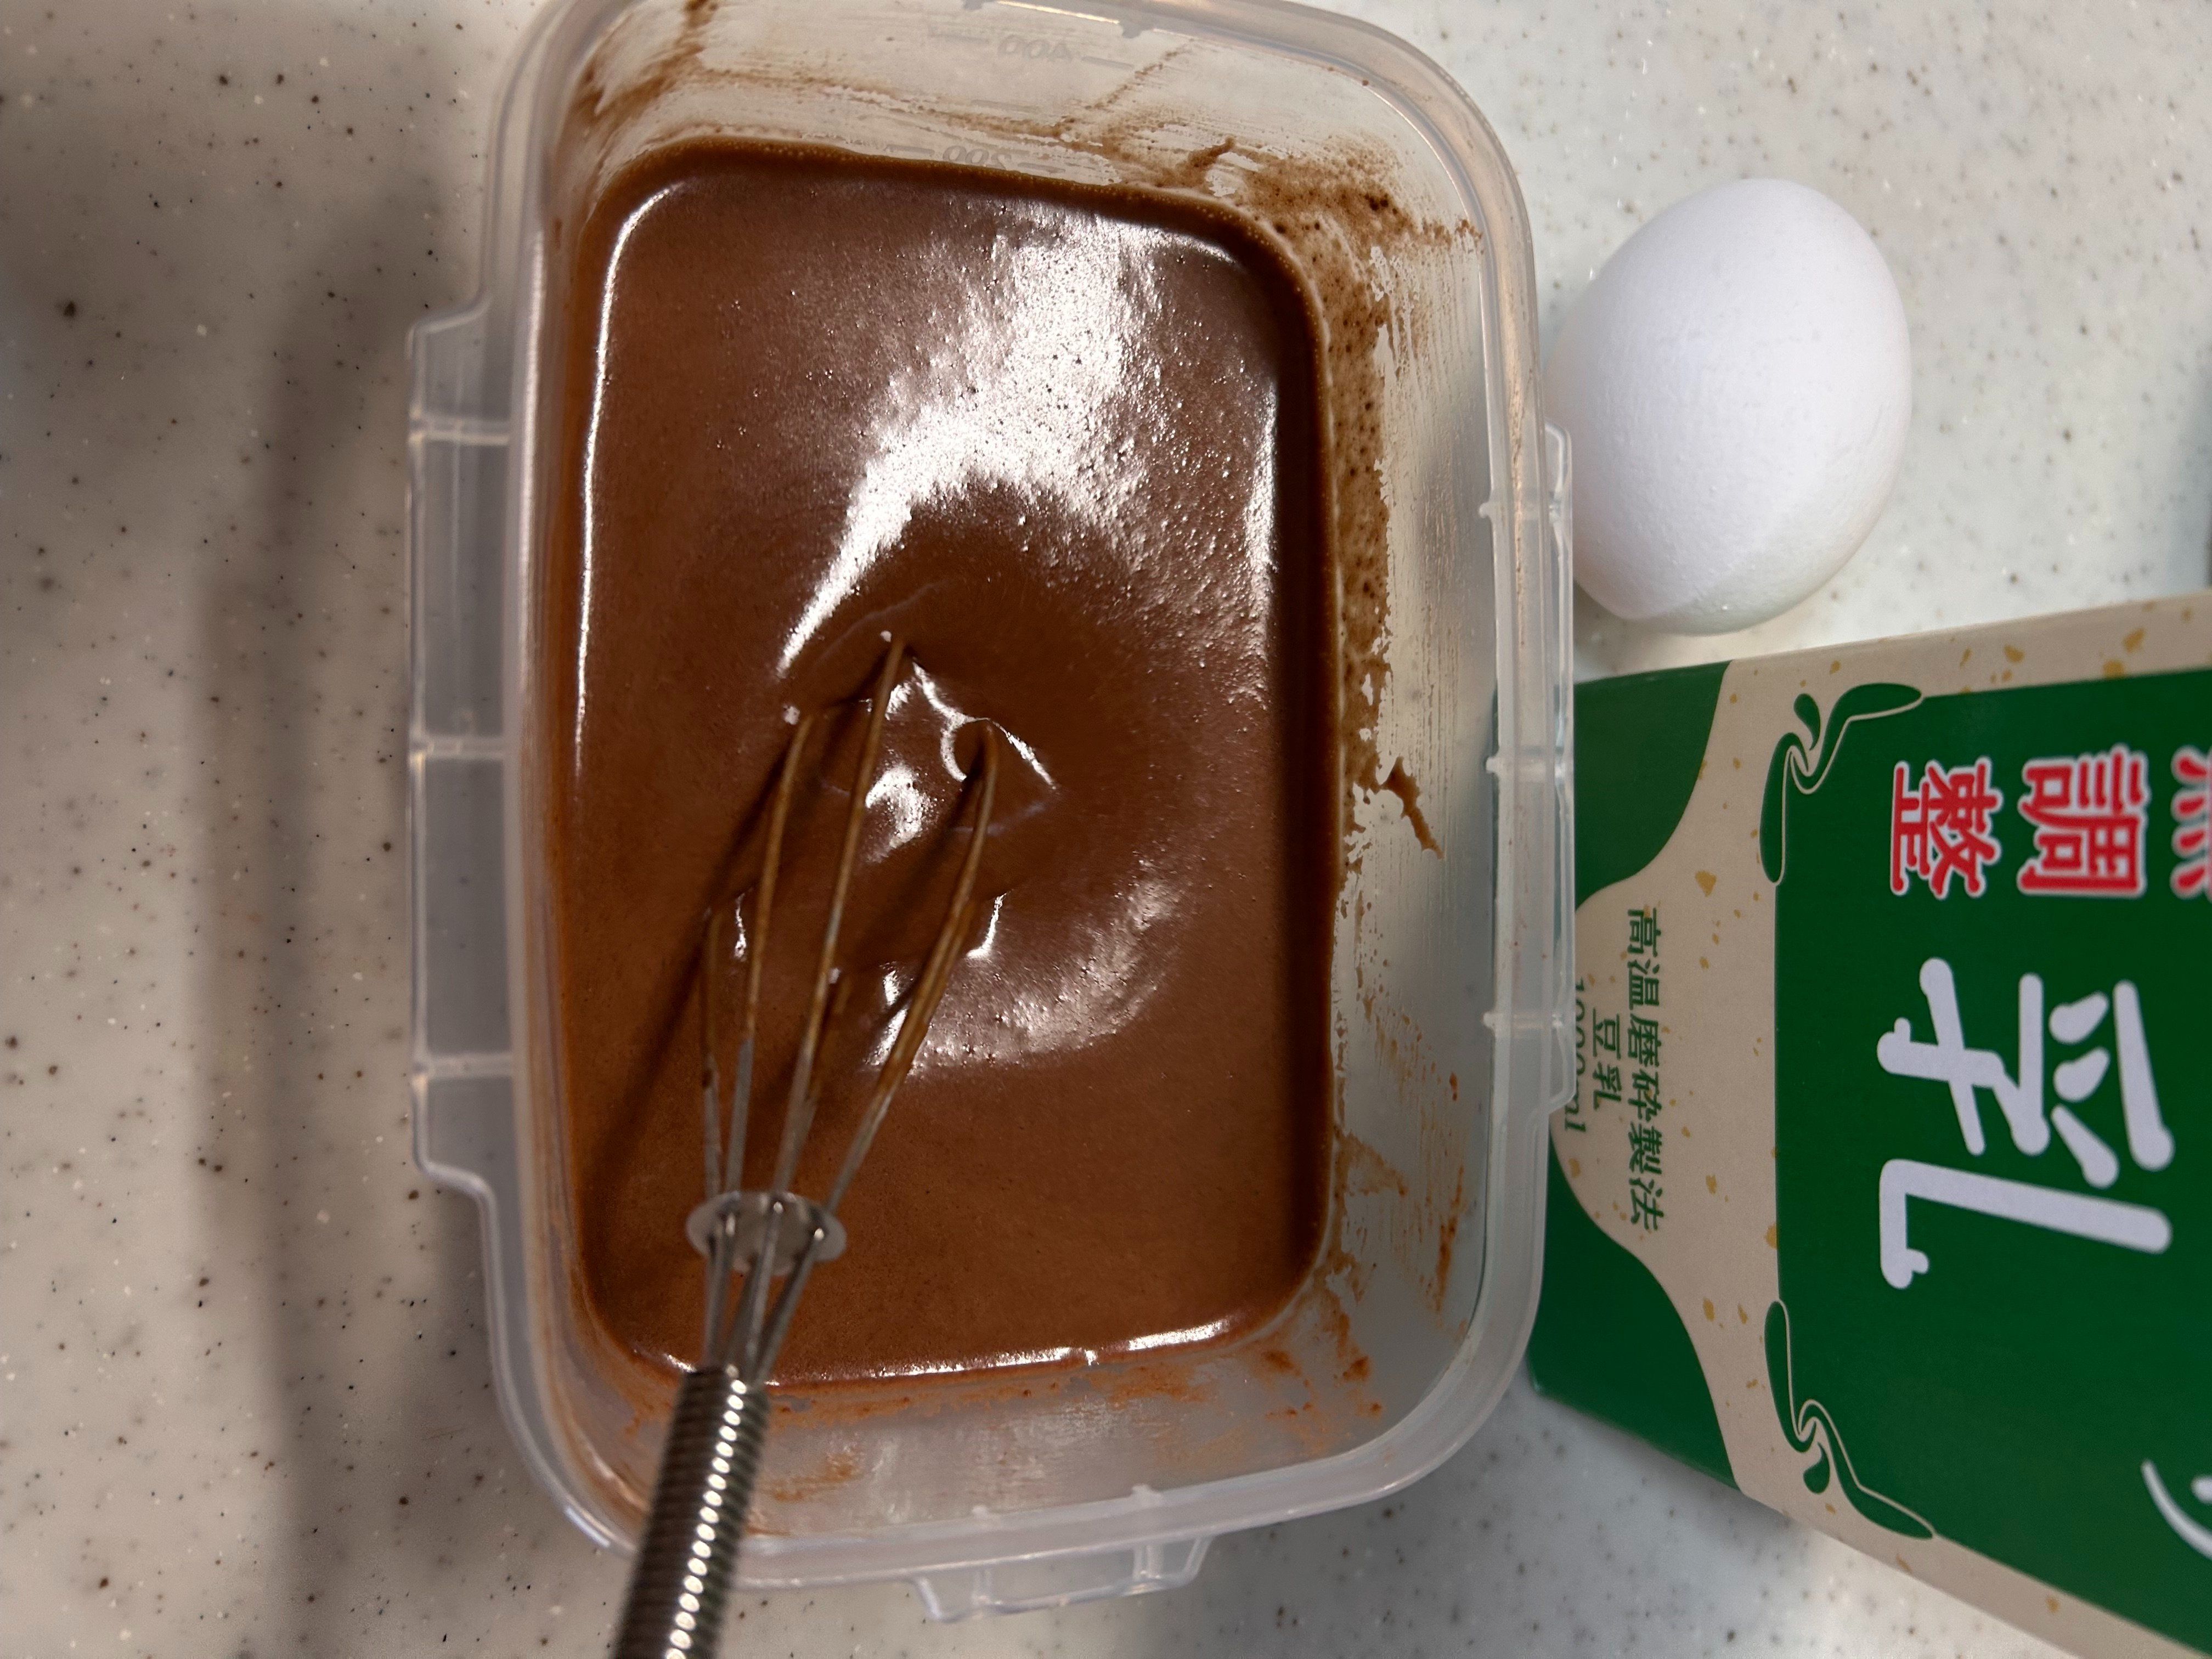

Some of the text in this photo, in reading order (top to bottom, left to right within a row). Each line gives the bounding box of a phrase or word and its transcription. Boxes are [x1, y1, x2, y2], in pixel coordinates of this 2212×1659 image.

[1891, 745, 2211, 899] 調整
[1593, 1008, 1622, 1110] 豆乳
[1627, 907, 1664, 1231] 高温磨砕製法
[1878, 958, 2173, 1288] 乳
